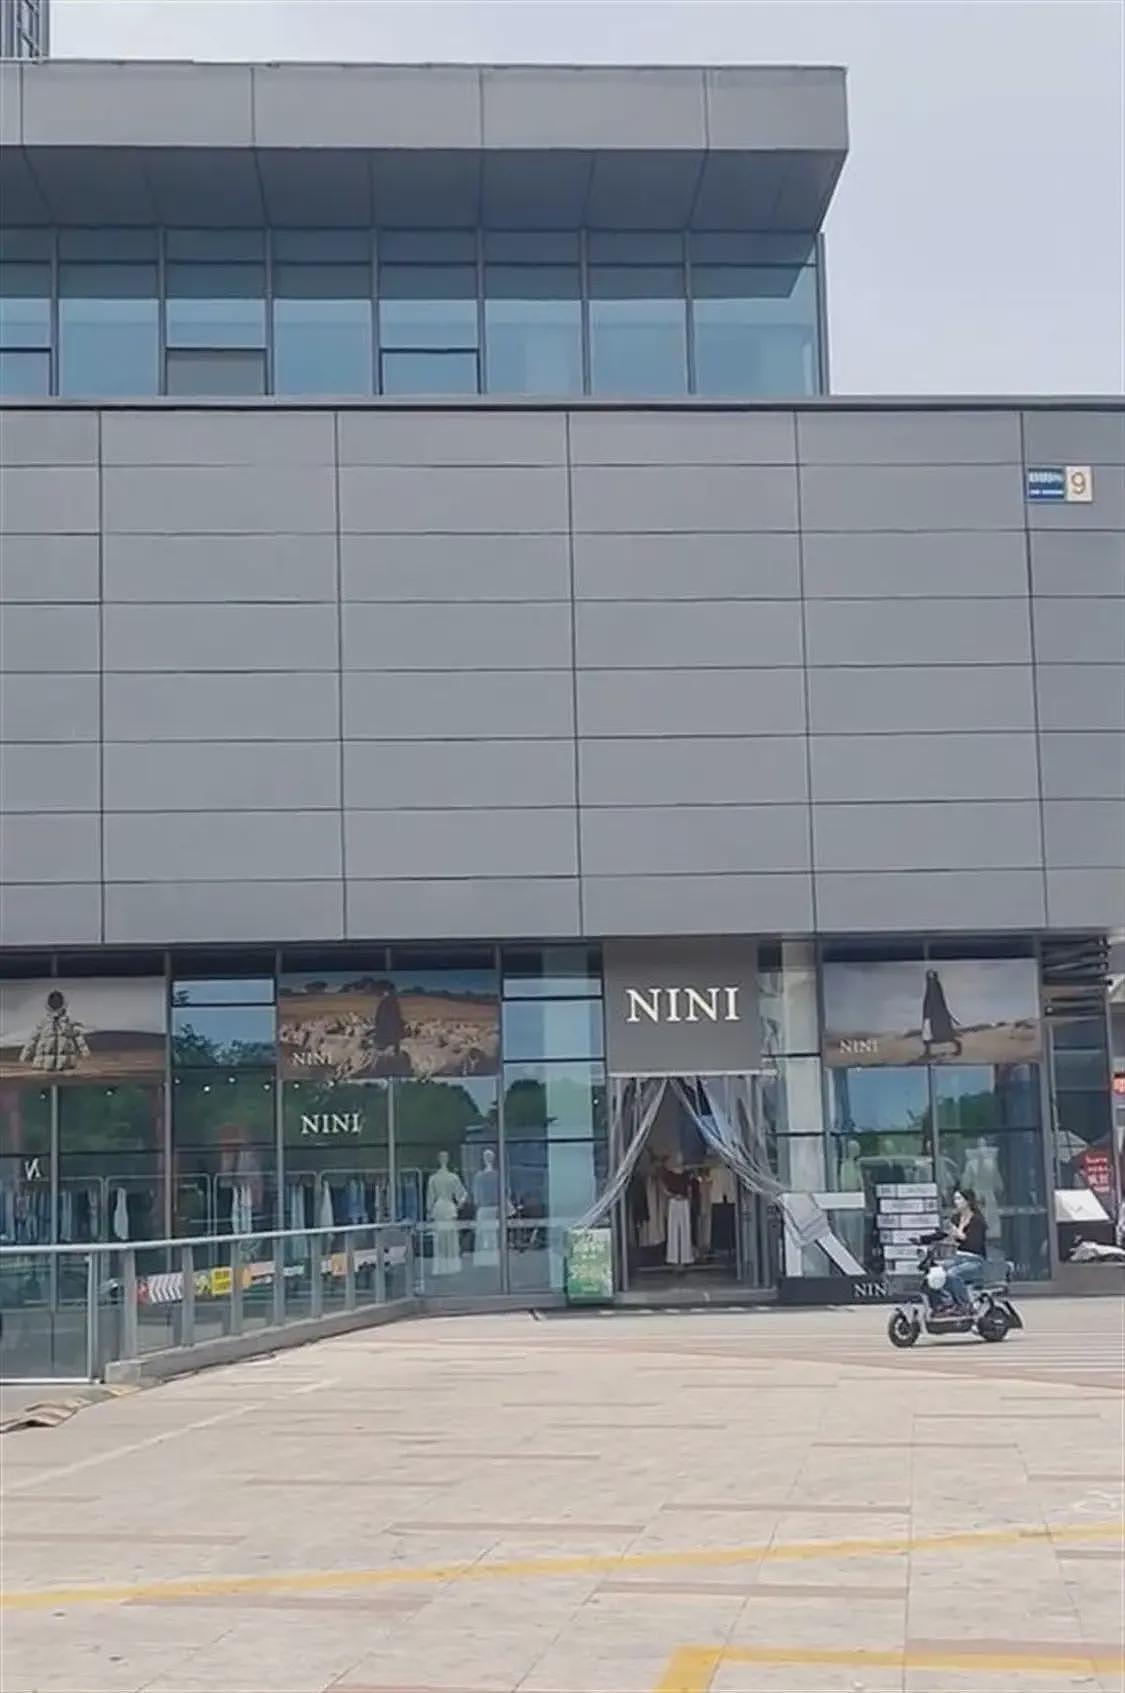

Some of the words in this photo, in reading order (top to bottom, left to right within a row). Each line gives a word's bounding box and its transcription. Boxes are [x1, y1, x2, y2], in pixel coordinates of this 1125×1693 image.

[1071, 472, 1086, 494] 9
[625, 987, 740, 1022] NINI
[840, 1039, 878, 1053] NINI
[293, 1052, 332, 1065] NINI
[301, 1113, 359, 1133] NINI
[854, 1283, 892, 1297] NIN
